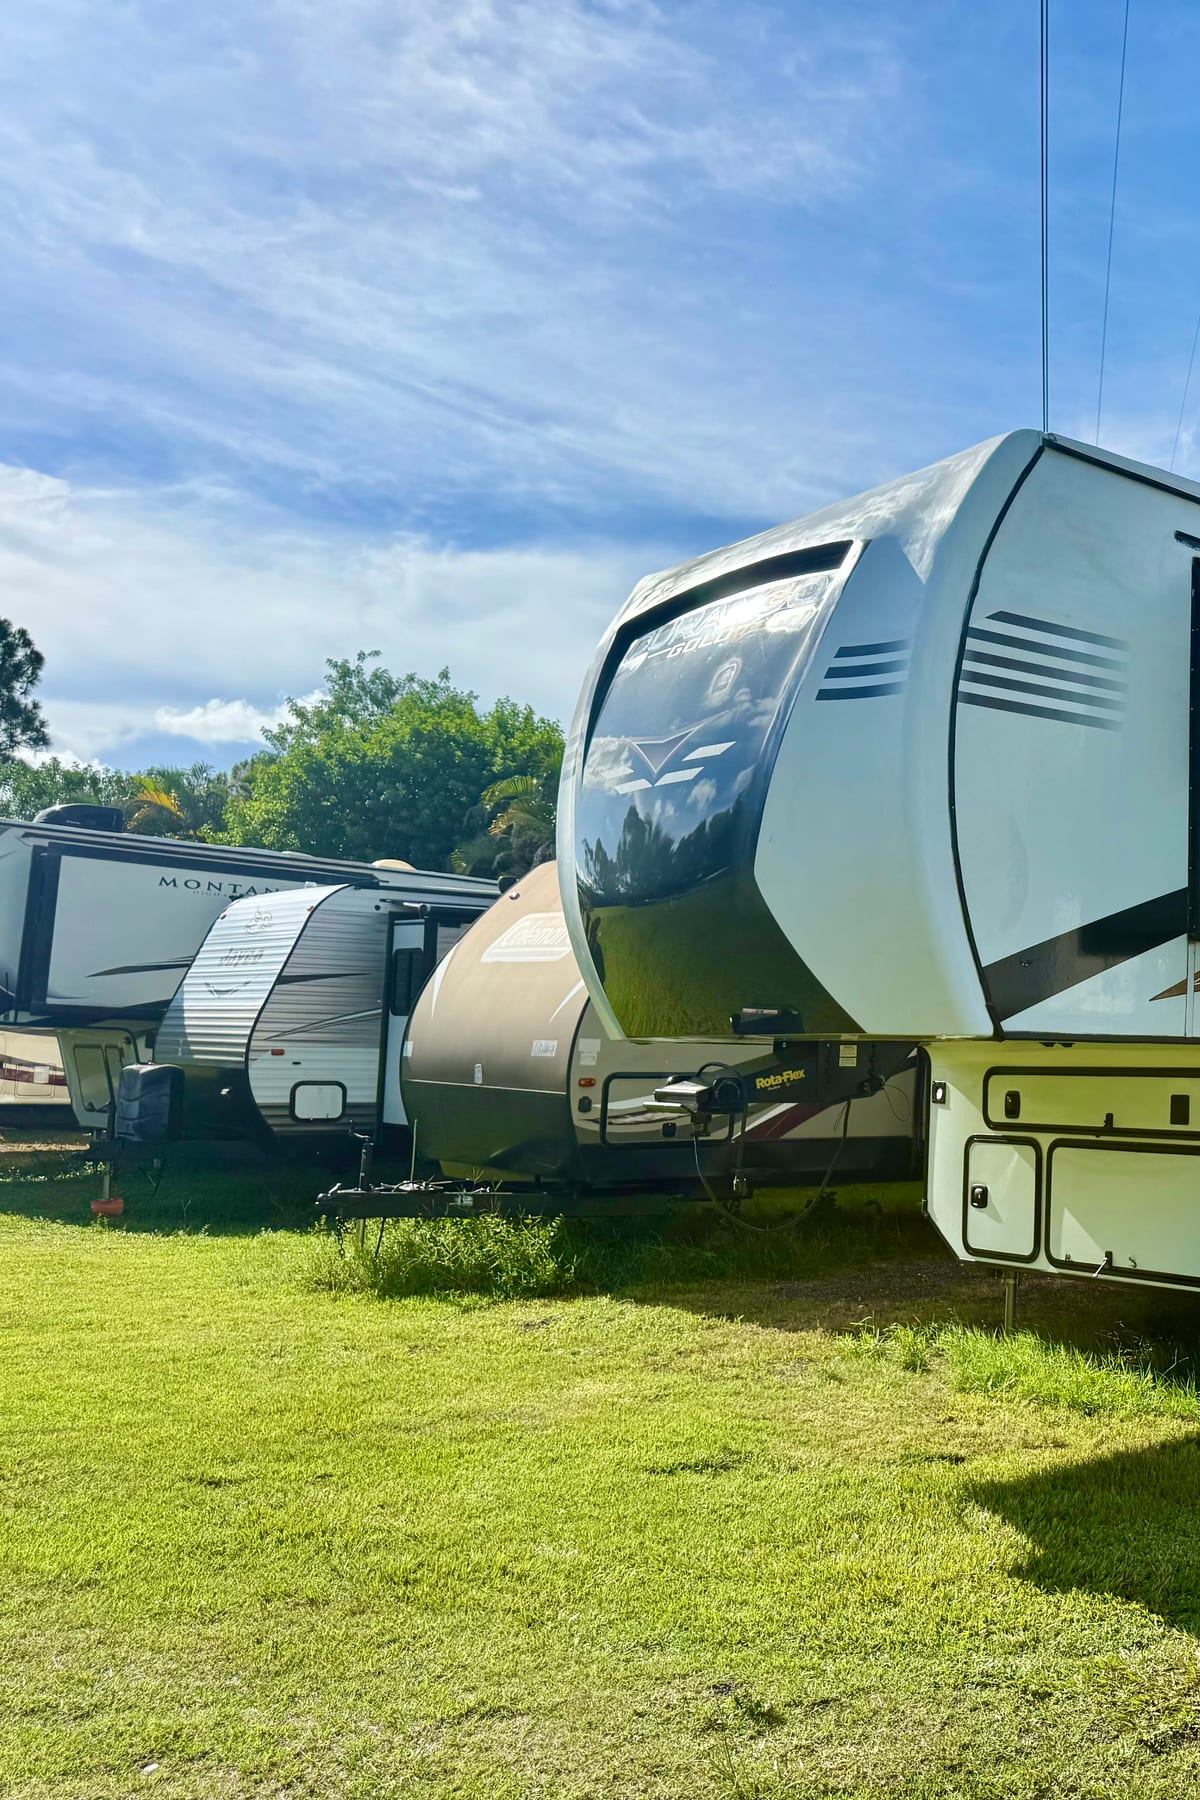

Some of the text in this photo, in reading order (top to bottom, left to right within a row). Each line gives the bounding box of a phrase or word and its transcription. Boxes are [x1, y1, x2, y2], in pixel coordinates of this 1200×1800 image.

[667, 630, 732, 658] GOLD
[158, 876, 279, 895] MONTAN
[755, 1069, 806, 1089] Rota-Flex
